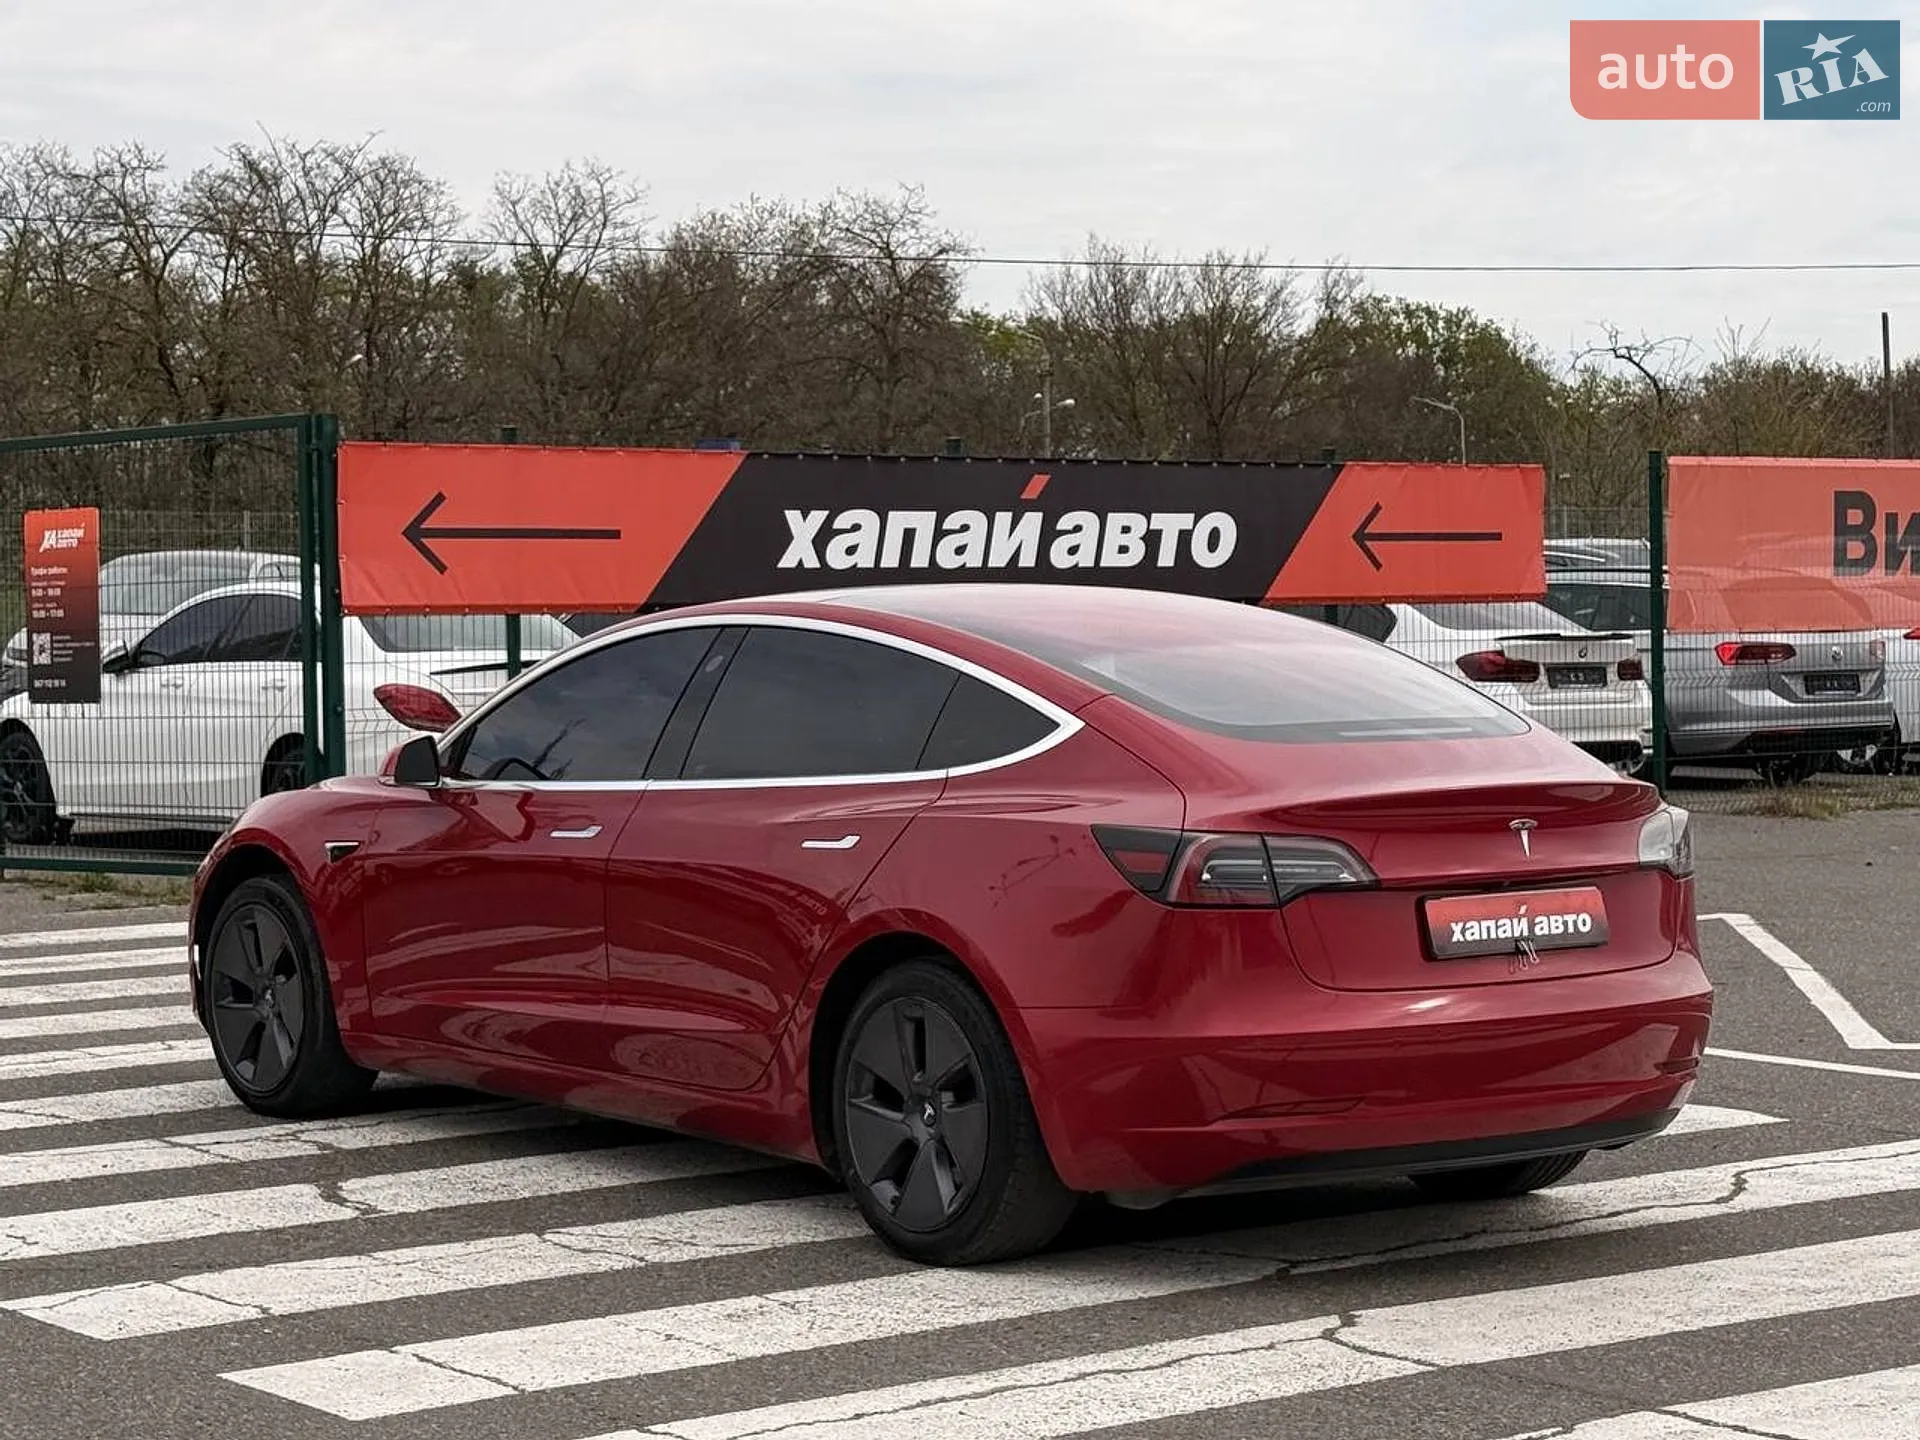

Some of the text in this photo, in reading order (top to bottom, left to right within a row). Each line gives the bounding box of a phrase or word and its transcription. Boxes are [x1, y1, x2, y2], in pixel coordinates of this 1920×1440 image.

[1049, 510, 1238, 568] авто
[1451, 904, 1592, 942] хапай авто
